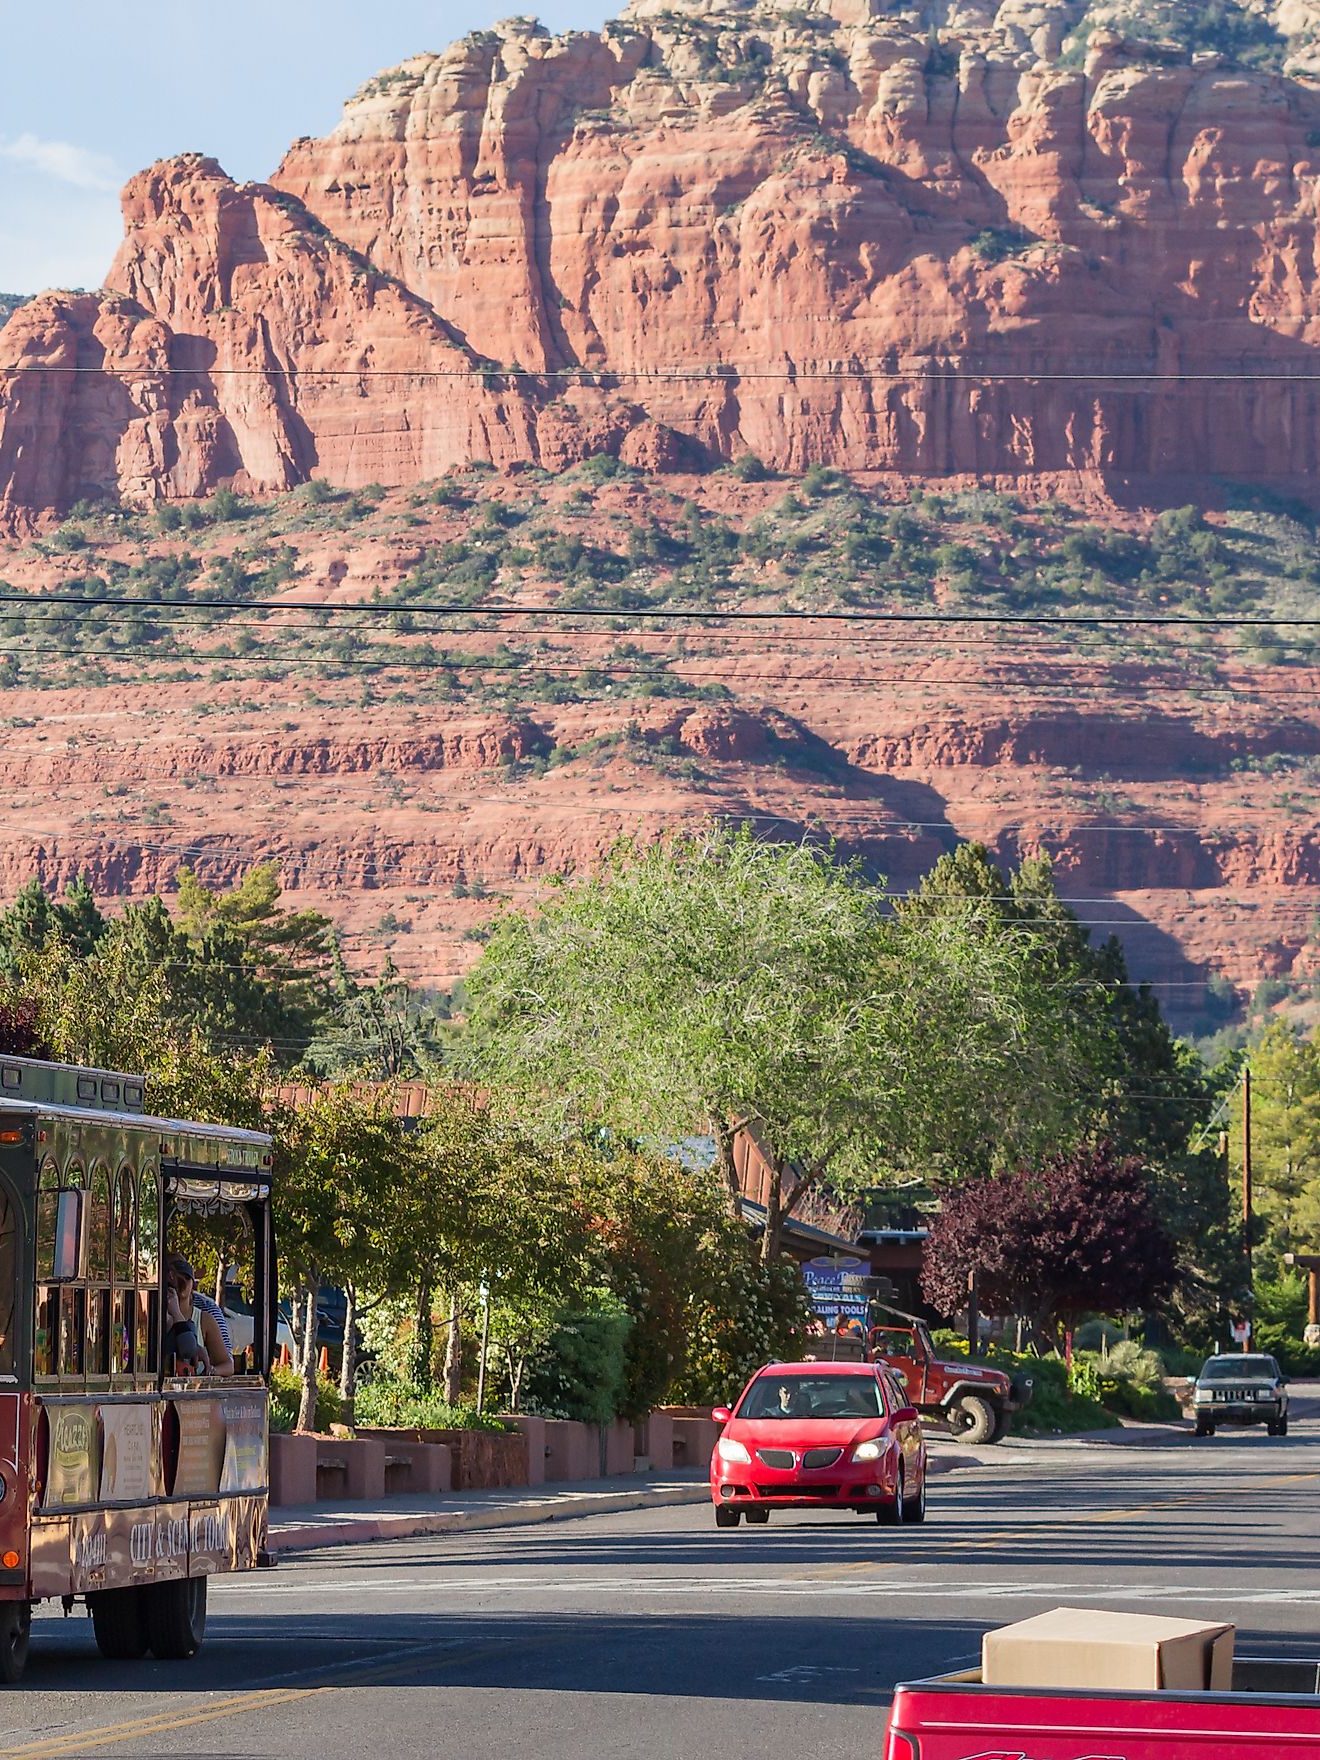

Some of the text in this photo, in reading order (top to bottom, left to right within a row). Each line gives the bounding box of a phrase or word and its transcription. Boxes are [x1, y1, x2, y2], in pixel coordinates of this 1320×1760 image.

[804, 1271, 836, 1286] Peace
[808, 1305, 865, 1315] ALING TOOLS
[130, 1523, 154, 1561] CITY
[155, 1522, 165, 1558] &
[167, 1517, 201, 1557] SCENIC
